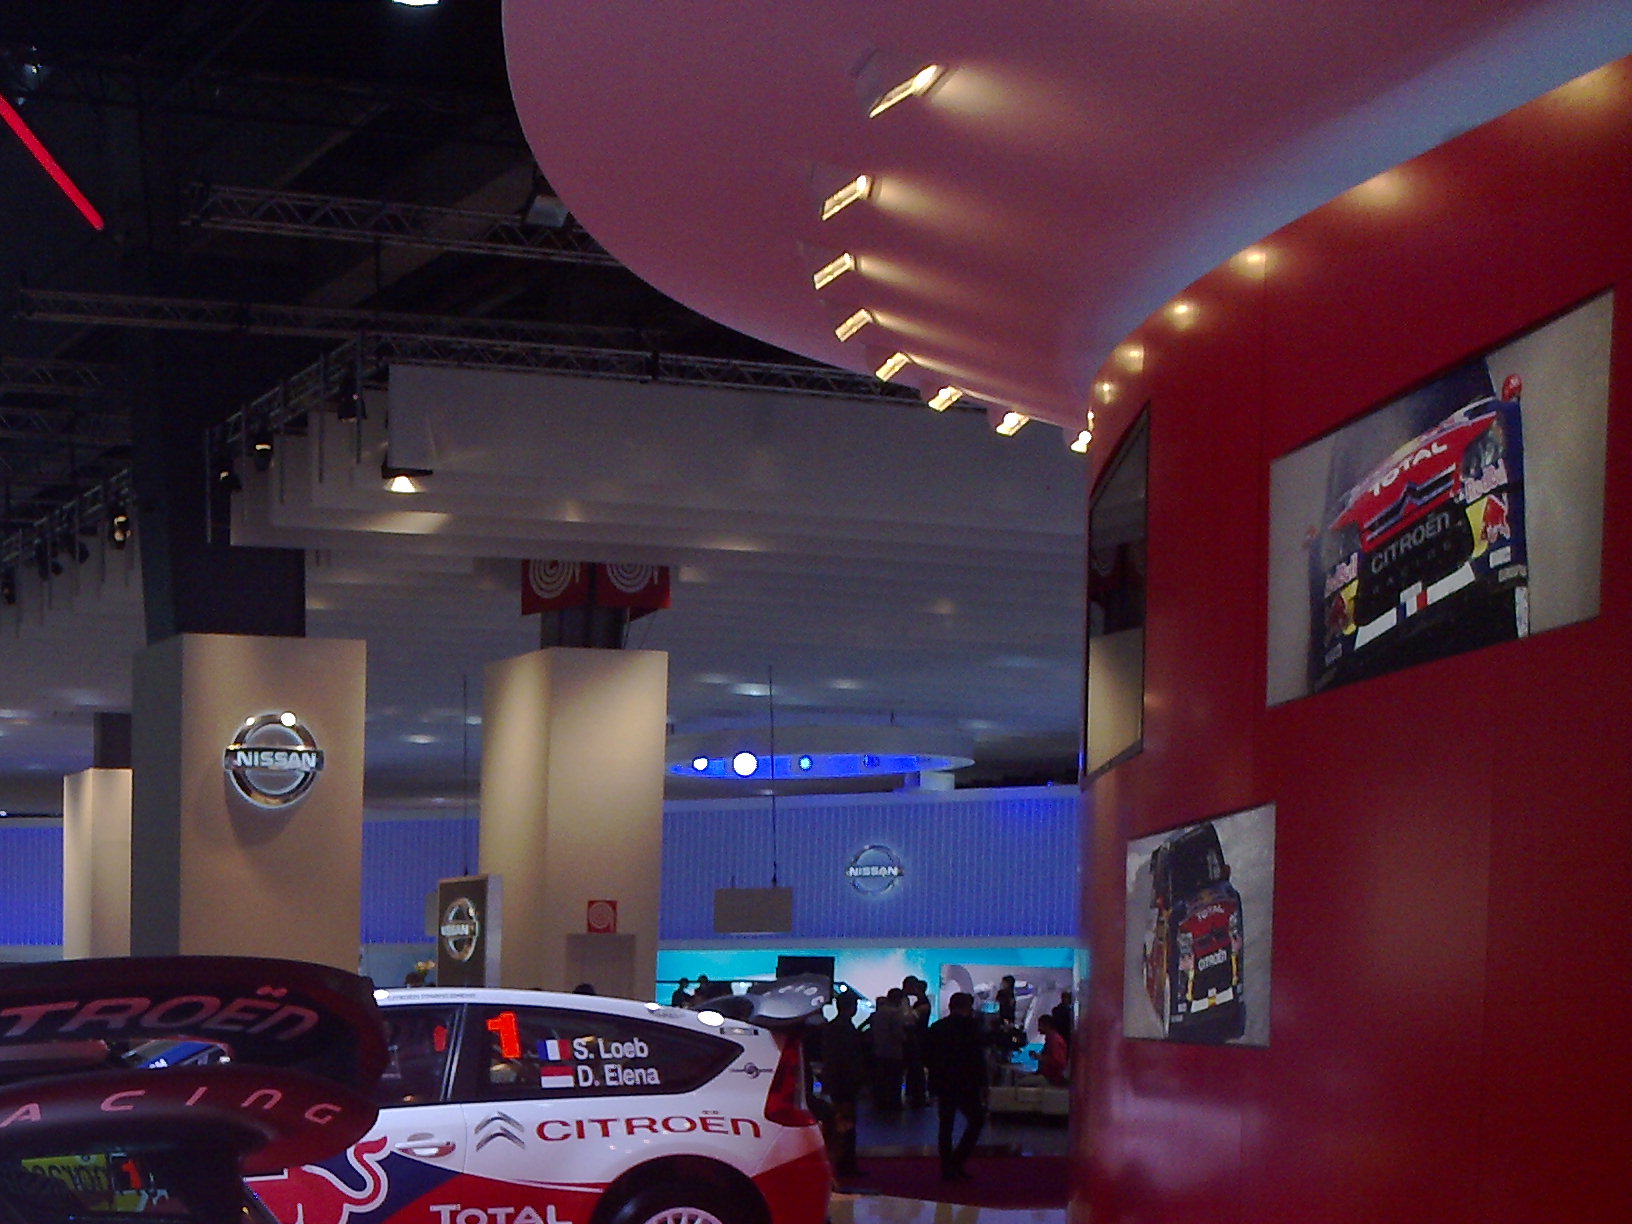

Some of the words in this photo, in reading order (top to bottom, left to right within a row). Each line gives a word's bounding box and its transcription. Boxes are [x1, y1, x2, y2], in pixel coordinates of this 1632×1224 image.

[1371, 441, 1448, 496] TOTAL
[235, 750, 317, 771] NISSAN
[848, 866, 899, 877] NISSAN
[485, 1011, 521, 1059] 1
[573, 1039, 594, 1060] S.
[599, 1037, 649, 1060] Loeb
[577, 1066, 599, 1088] D.
[604, 1065, 660, 1087] Elena
